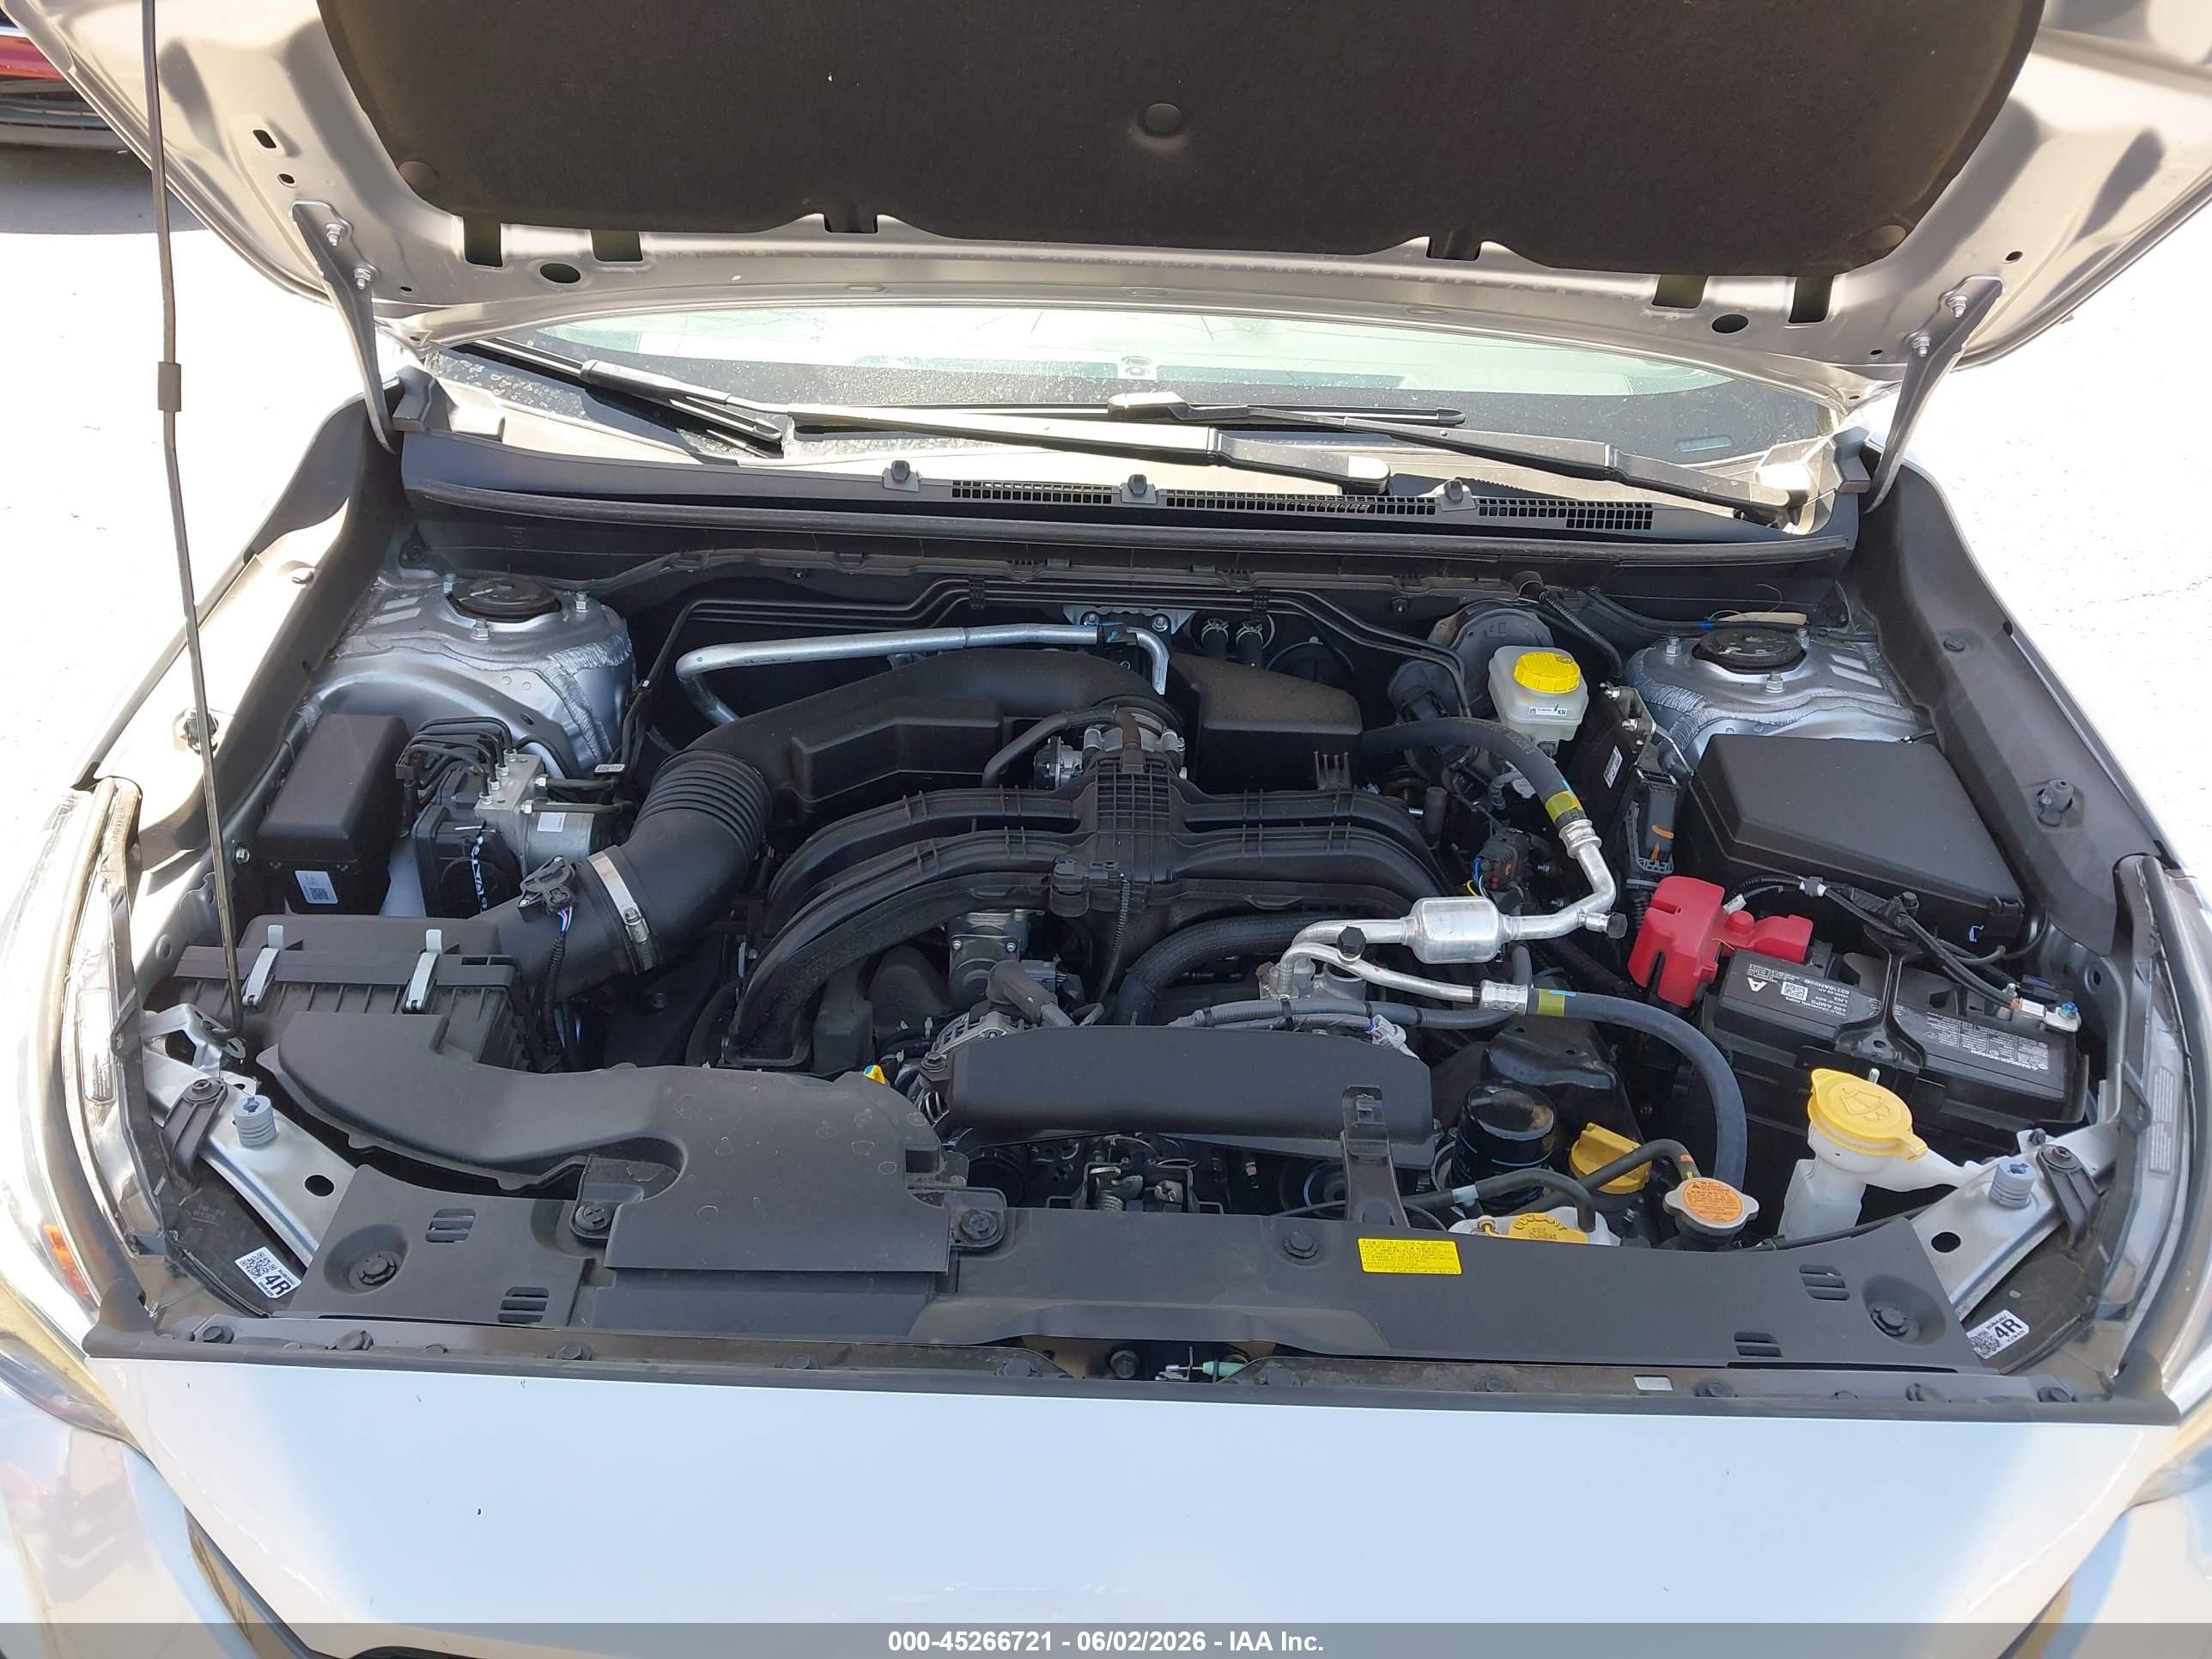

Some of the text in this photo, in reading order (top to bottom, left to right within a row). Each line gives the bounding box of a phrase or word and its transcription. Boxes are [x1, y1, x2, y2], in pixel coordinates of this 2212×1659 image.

[1810, 999, 1832, 1008] AMPS
[1513, 1214, 1567, 1231] COOLANT
[264, 1275, 291, 1296] 4R
[1995, 1318, 2022, 1339] 4R
